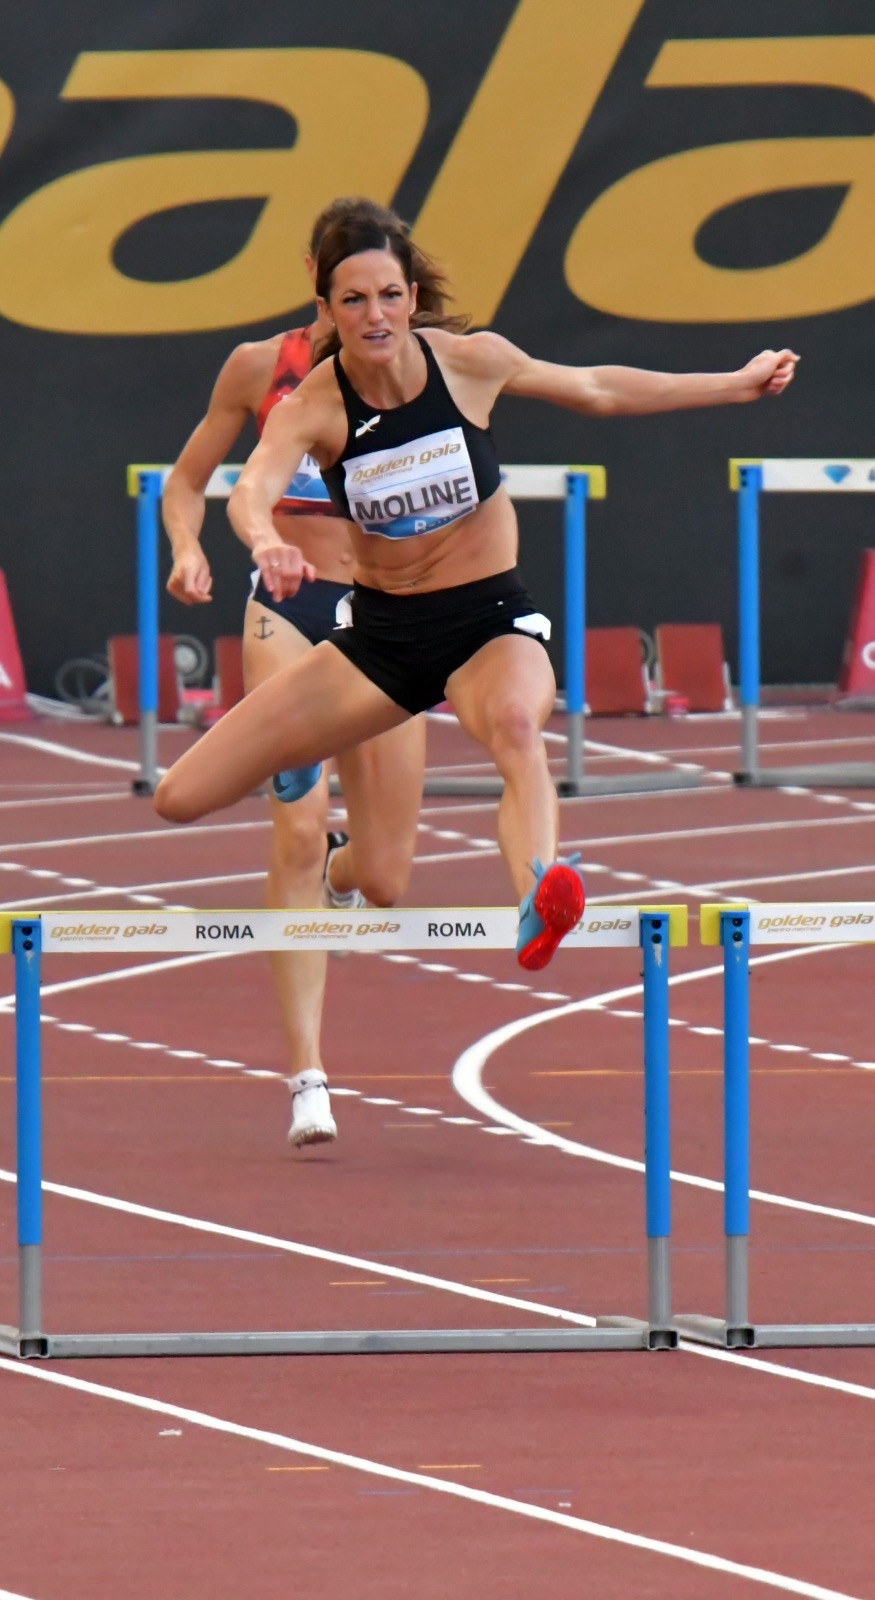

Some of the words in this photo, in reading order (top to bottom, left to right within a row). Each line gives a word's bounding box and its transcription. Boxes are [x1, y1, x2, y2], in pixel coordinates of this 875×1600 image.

[0, 0, 875, 335] ala
[351, 455, 415, 482] golden
[420, 443, 461, 464] gala
[355, 476, 473, 521] MOLINE
[282, 922, 353, 936] golden
[356, 921, 401, 935] gala
[587, 919, 632, 933] gala
[757, 915, 827, 930] golden
[829, 913, 874, 927] gala
[50, 924, 120, 938] golden
[122, 923, 168, 937] gala
[196, 924, 254, 939] ROMA
[428, 922, 487, 938] ROMA
